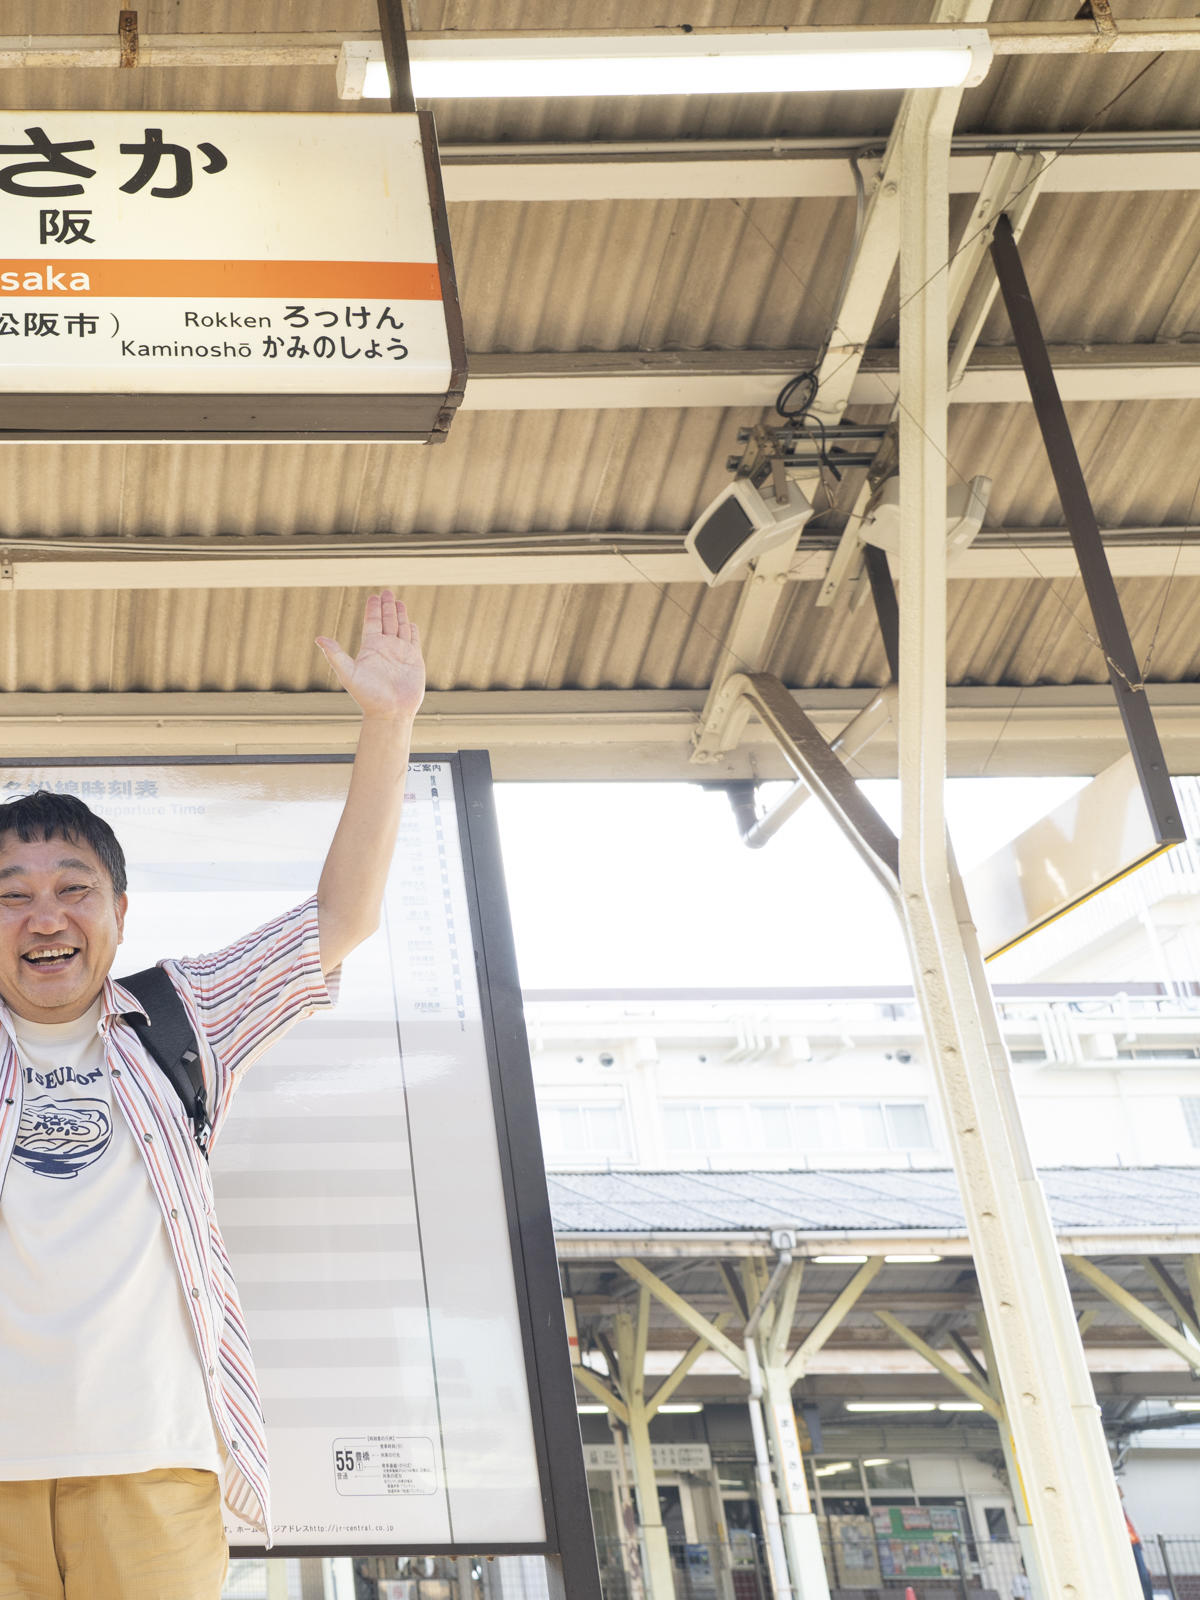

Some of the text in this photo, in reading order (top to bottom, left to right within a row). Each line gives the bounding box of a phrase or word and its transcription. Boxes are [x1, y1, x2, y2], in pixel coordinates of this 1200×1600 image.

[184, 312, 271, 328] Rokken
[122, 335, 408, 360] Kaminoshō かみのしょう
[173, 804, 205, 815] Time
[336, 1451, 354, 1471] 55
